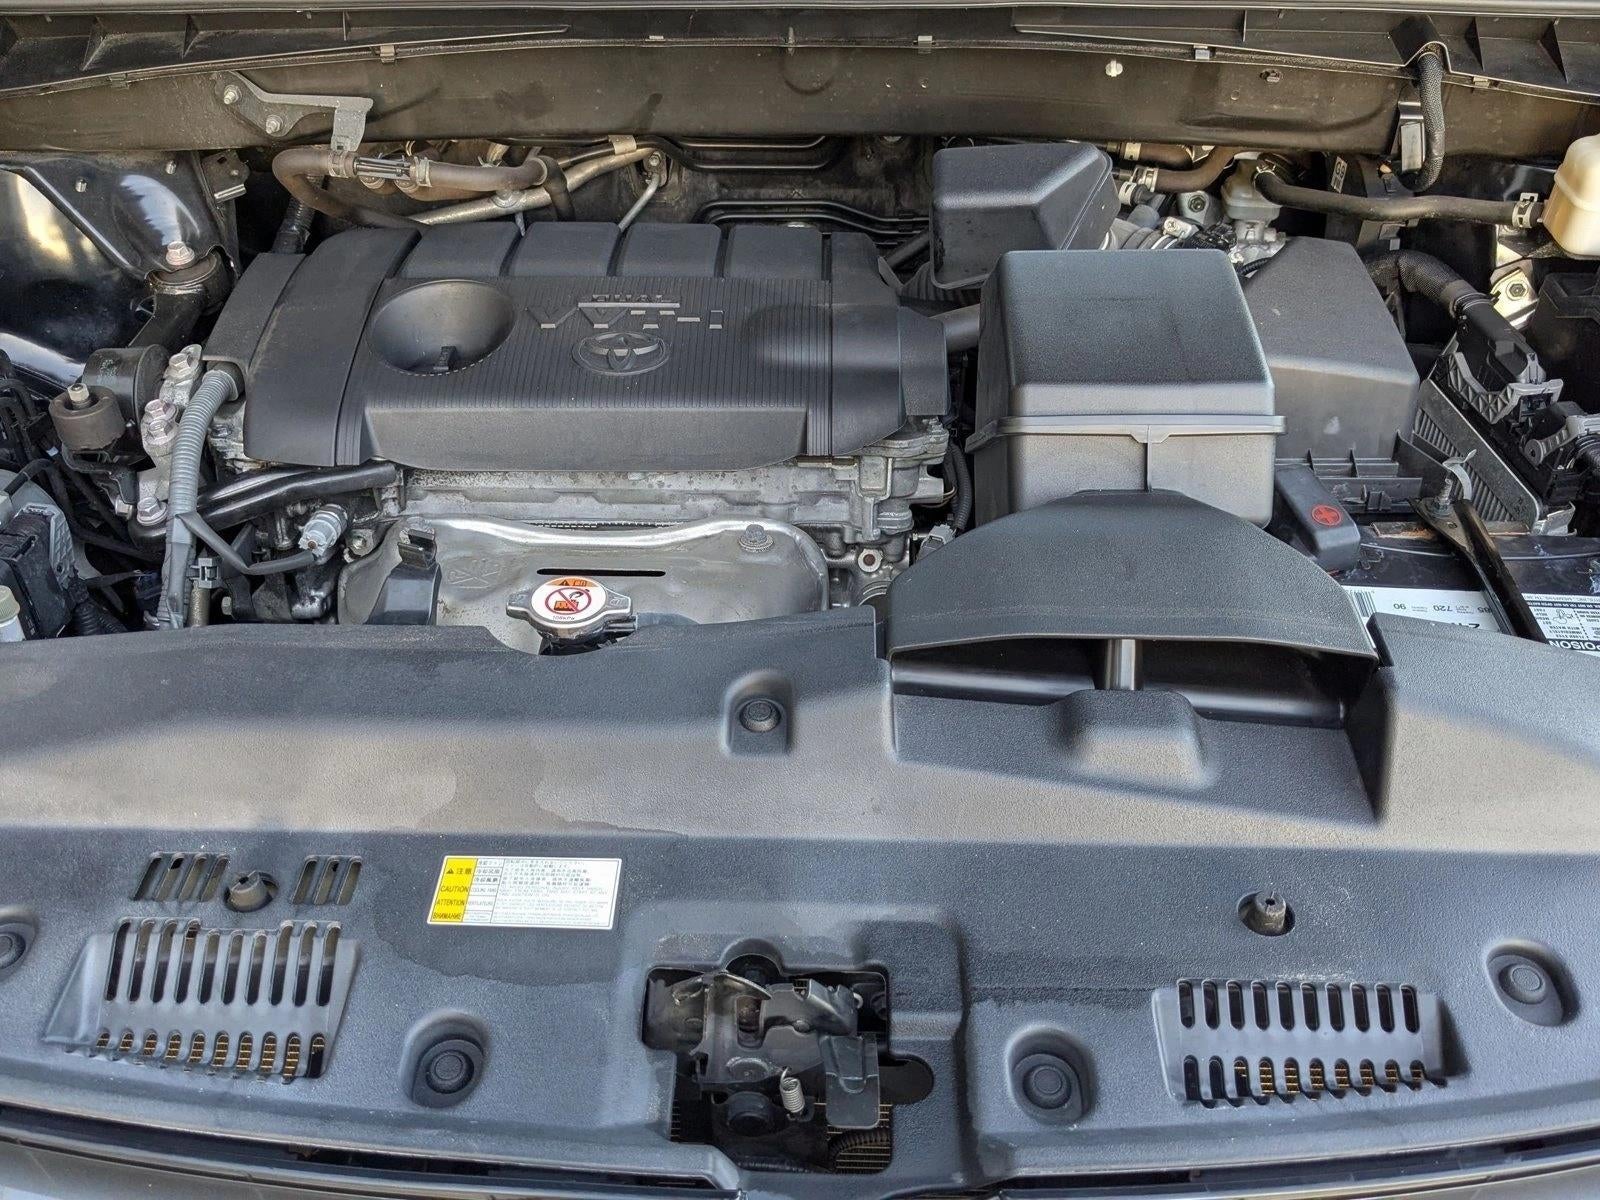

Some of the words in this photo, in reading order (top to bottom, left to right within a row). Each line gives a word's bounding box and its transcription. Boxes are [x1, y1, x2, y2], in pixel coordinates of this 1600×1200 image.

[1477, 606, 1492, 614] 85
[440, 885, 469, 893] CAUTION
[436, 898, 465, 907] ATTENTION
